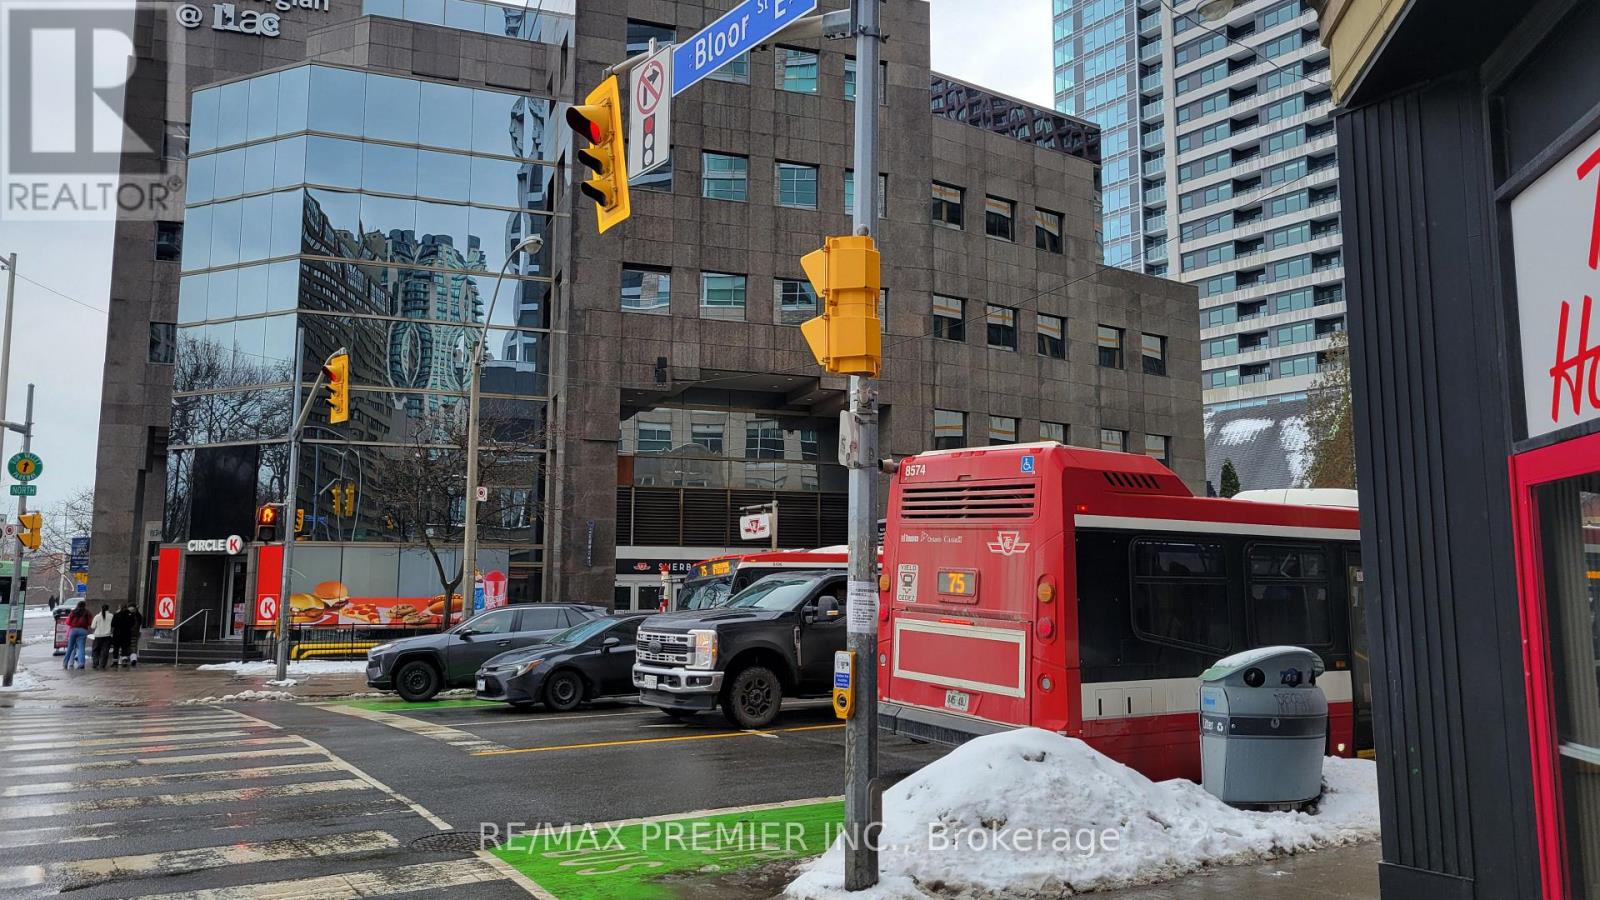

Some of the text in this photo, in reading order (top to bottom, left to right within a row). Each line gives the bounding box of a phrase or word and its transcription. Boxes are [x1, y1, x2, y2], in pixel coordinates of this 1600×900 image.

[695, 14, 749, 70] Bloor
[905, 464, 926, 476] 8574
[12, 485, 35, 495] NORTH
[188, 540, 225, 551] CIRCLE
[948, 573, 965, 593] 75
